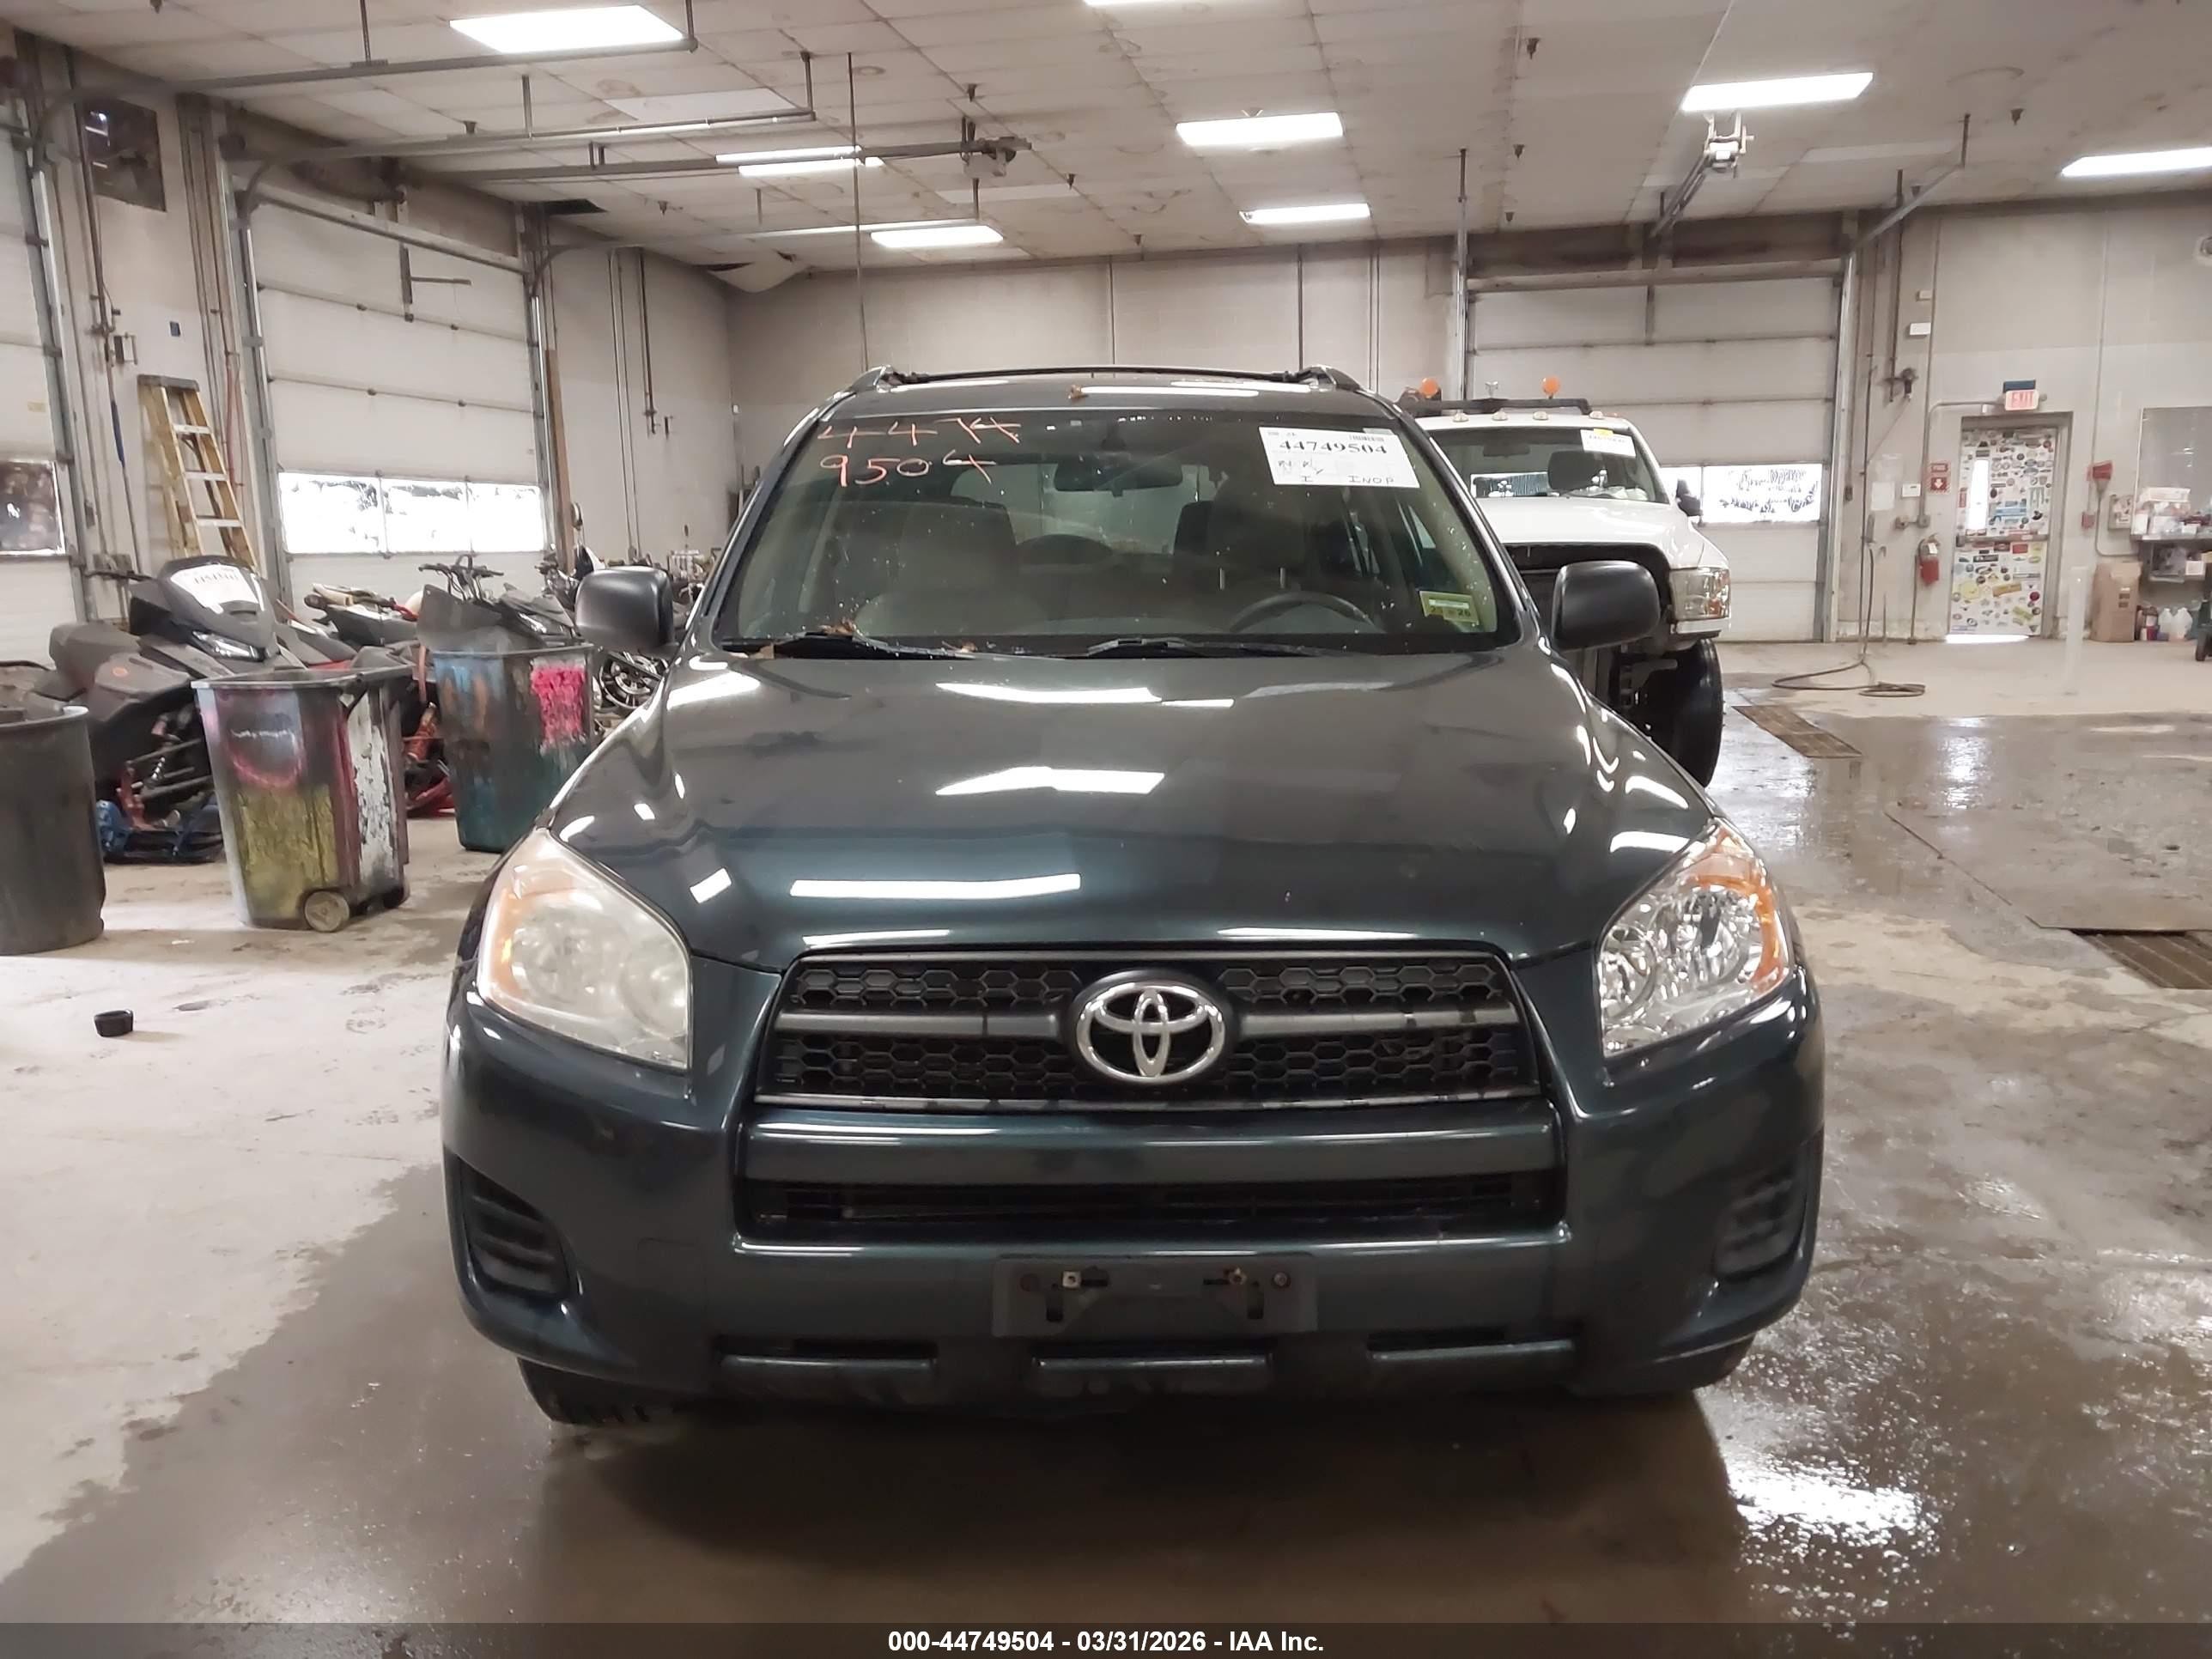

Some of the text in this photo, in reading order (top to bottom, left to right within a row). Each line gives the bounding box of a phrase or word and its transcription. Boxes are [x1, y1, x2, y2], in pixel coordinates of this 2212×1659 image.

[1279, 440, 1388, 454] 44749504
[820, 449, 997, 487] 9504
[1347, 475, 1395, 484] INOP
